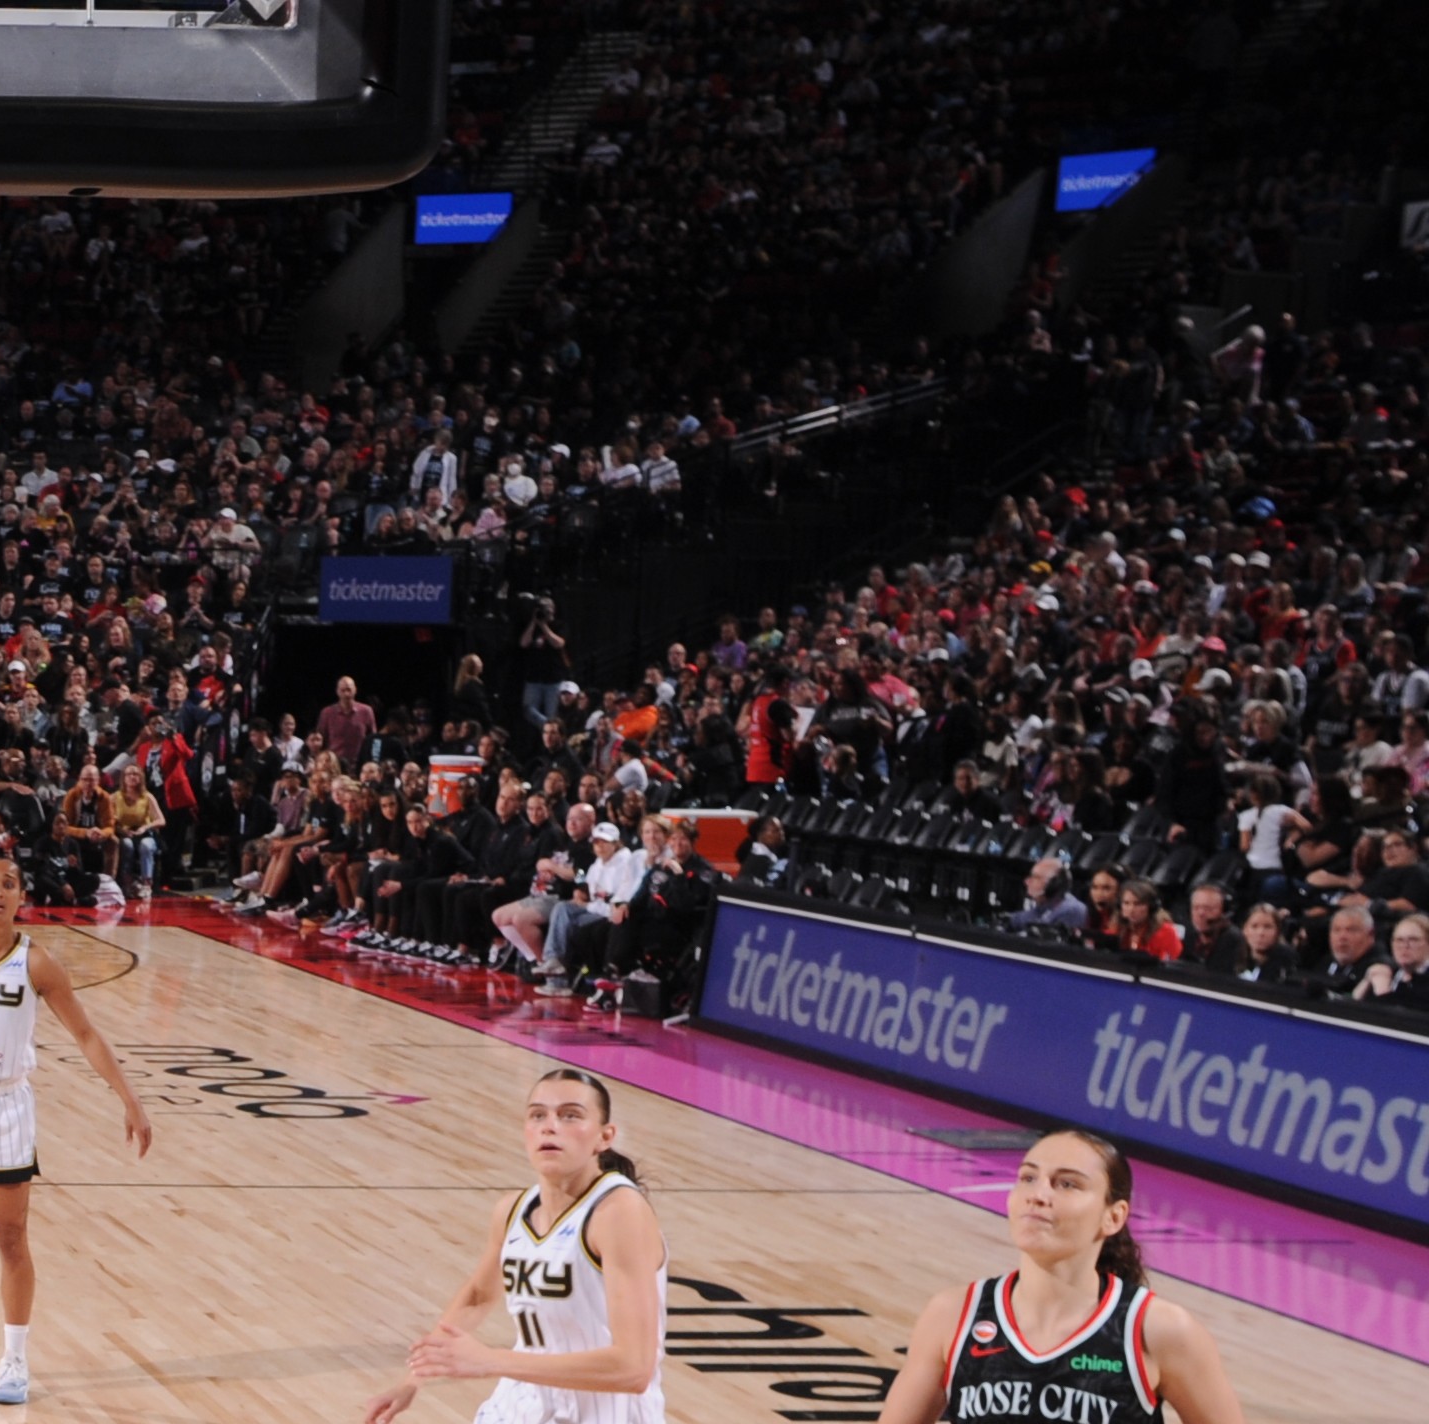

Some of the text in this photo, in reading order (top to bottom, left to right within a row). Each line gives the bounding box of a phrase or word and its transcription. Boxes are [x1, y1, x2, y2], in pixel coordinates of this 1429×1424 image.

[328, 578, 445, 602] ticketmaster
[726, 924, 1008, 1074] ticketmaster
[502, 1257, 573, 1298] SKY
[518, 1310, 546, 1348] 11
[1070, 1354, 1124, 1373] chime
[957, 1380, 1032, 1420] ROSE
